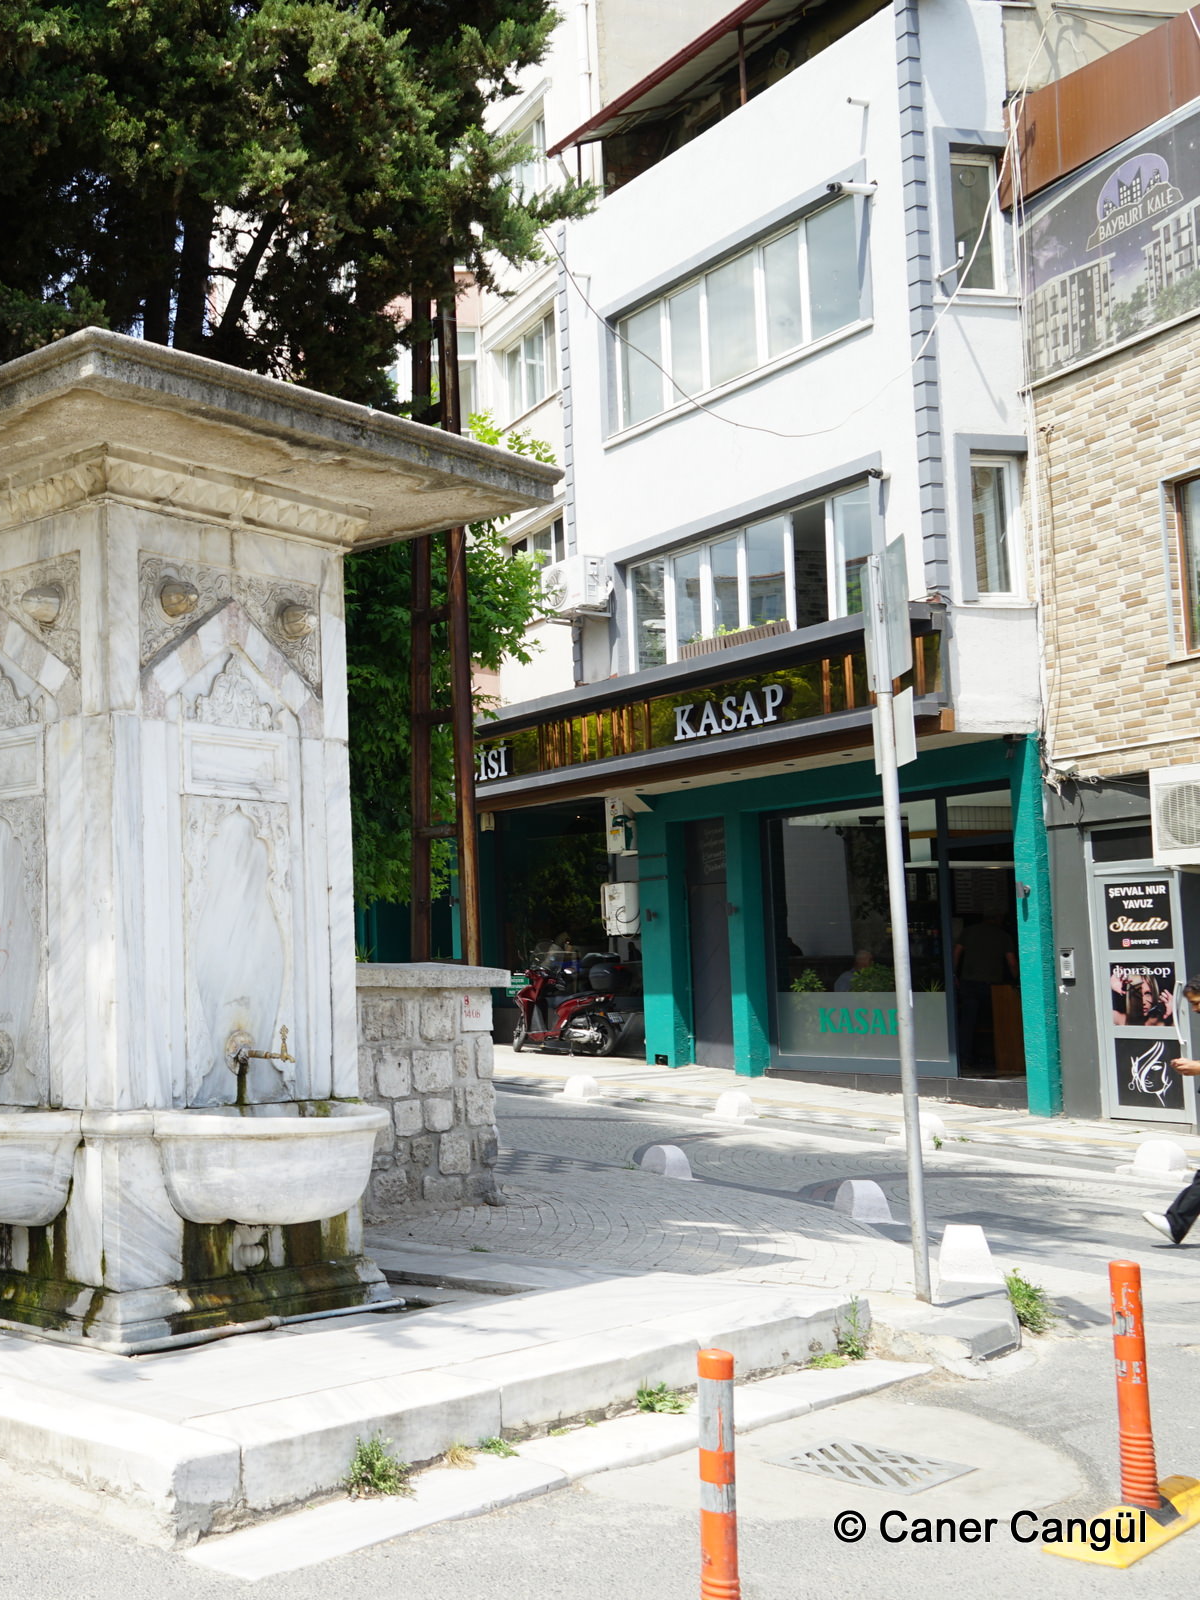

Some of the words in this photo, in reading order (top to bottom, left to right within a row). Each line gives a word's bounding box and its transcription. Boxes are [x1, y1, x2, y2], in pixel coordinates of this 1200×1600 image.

[1099, 204, 1143, 241] BAYBURT
[1147, 187, 1174, 215] KALE
[674, 684, 783, 741] KASAP
[474, 740, 508, 780] İSİ
[1108, 887, 1144, 898] ŞEVVAL
[1145, 885, 1167, 895] NUR
[1122, 899, 1154, 909] YAVUZ
[1109, 915, 1169, 932] Studio
[1112, 965, 1171, 979] фризьор
